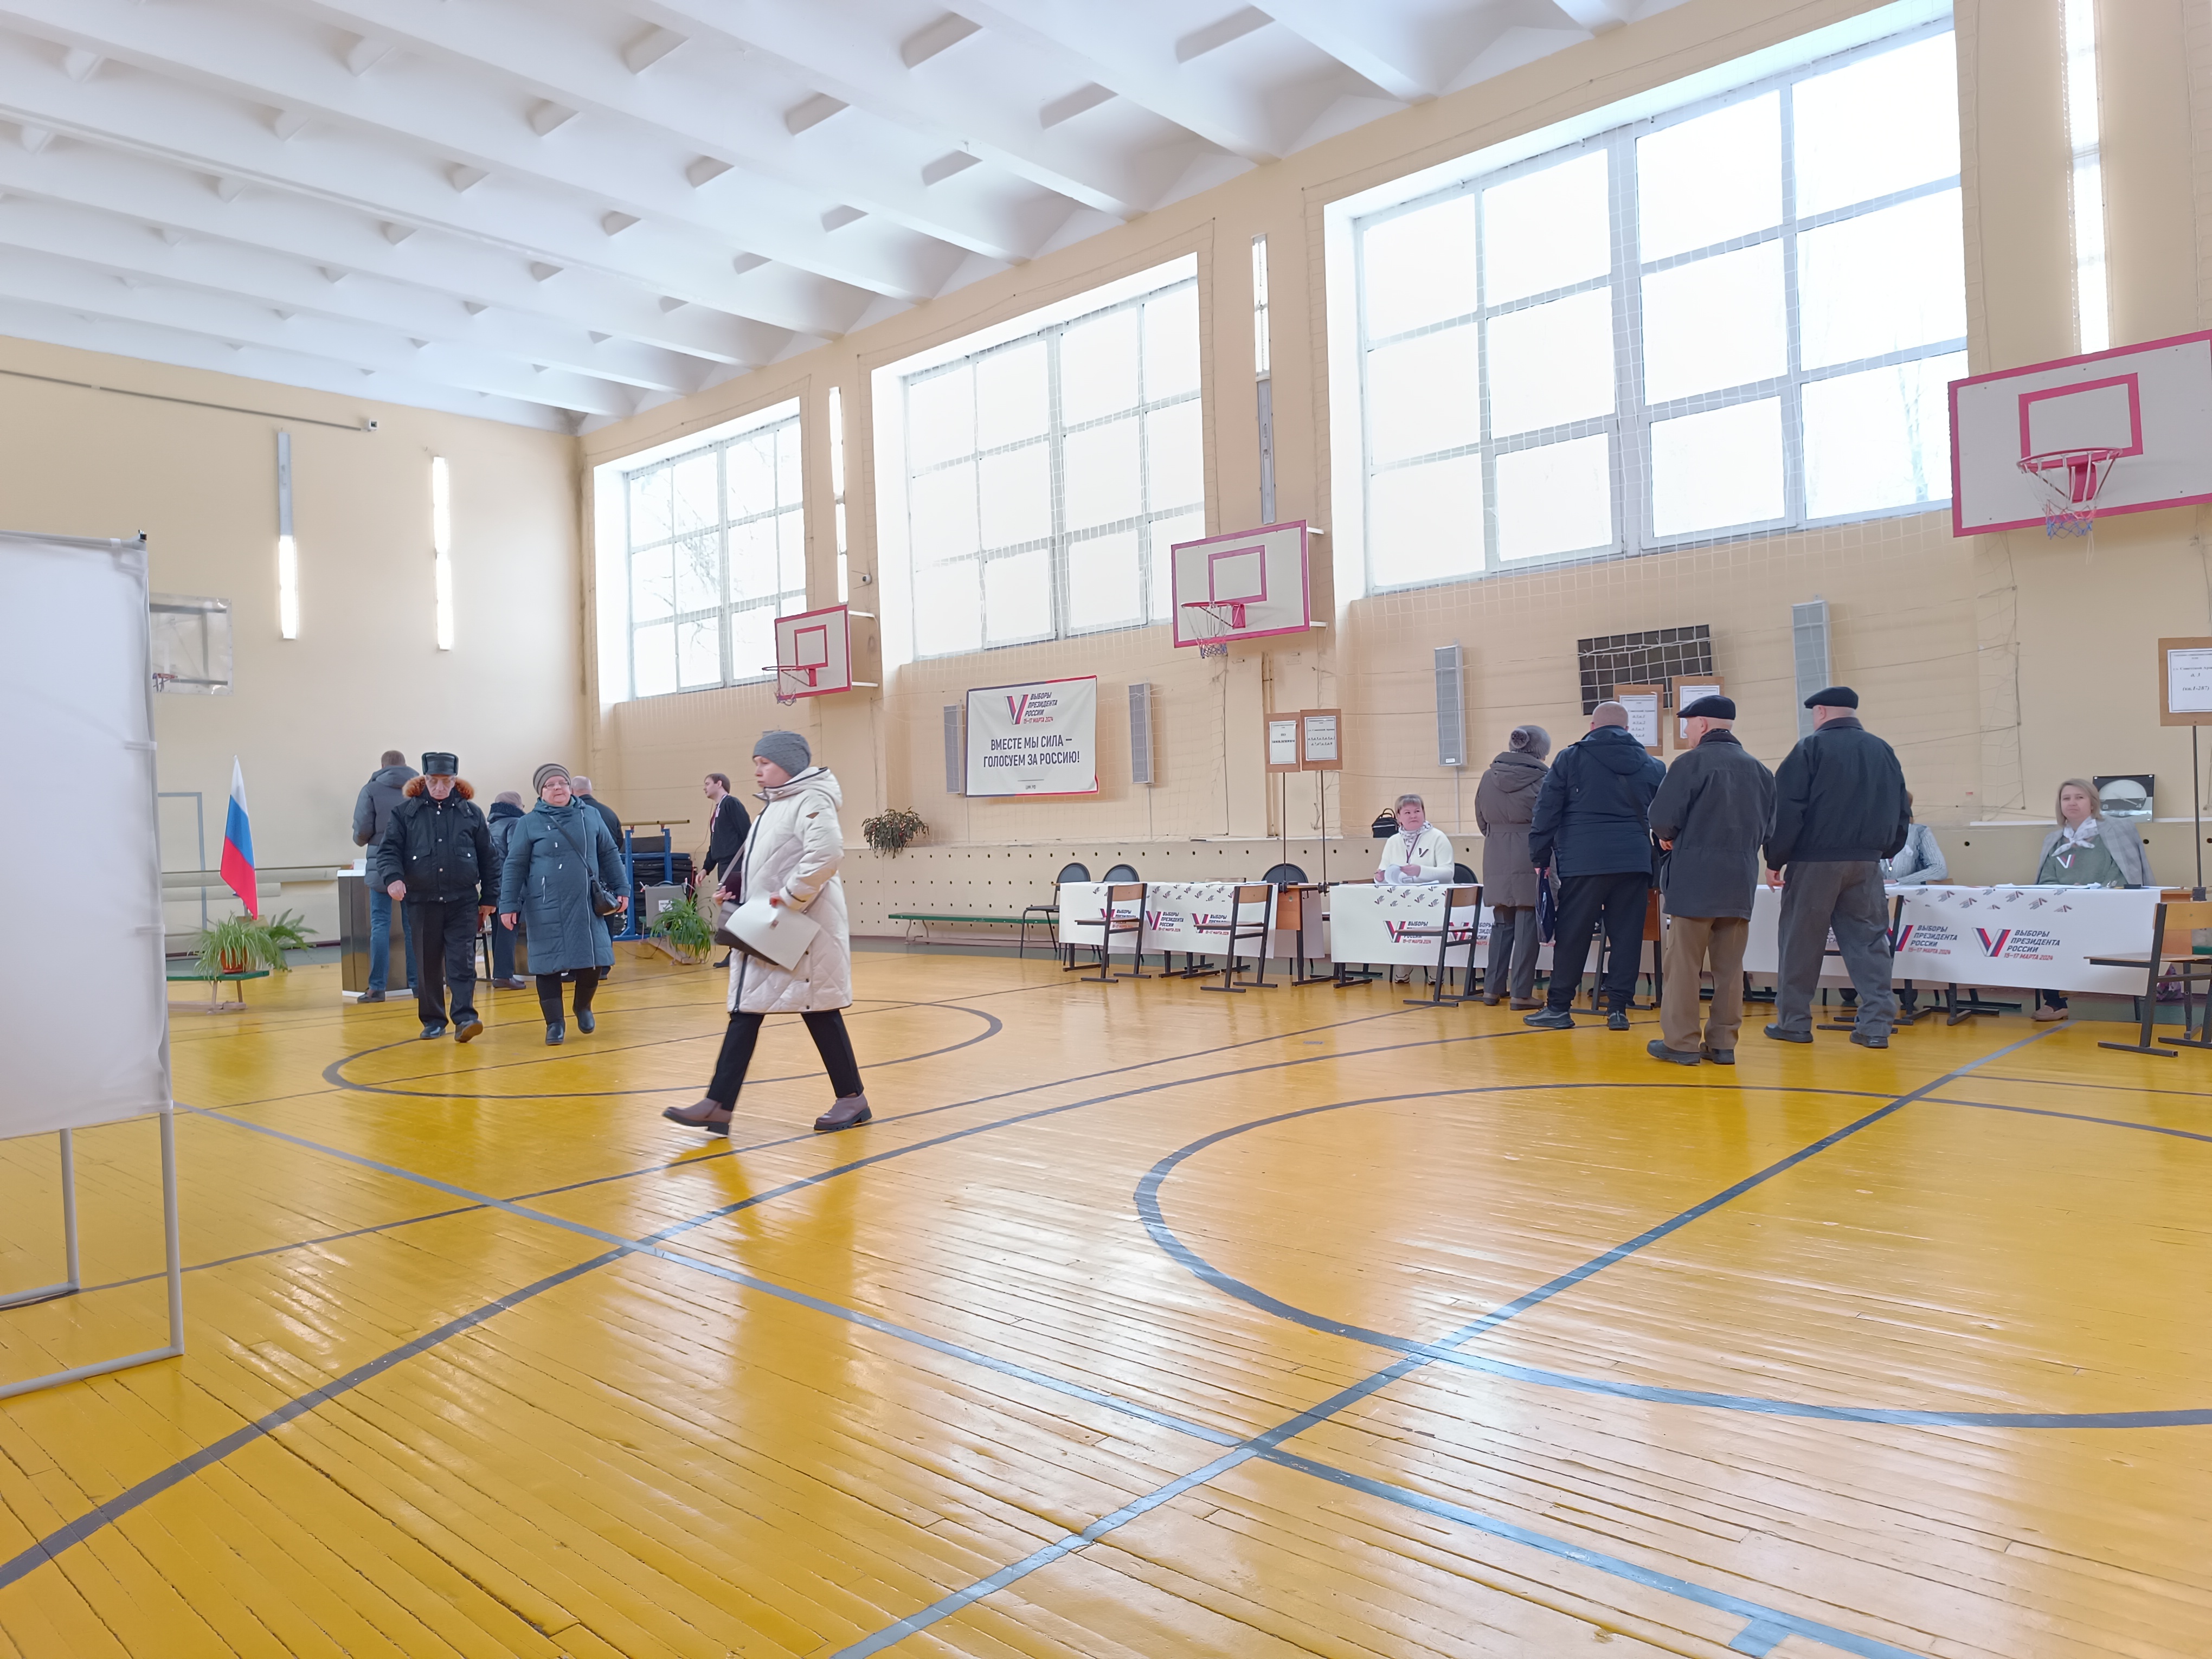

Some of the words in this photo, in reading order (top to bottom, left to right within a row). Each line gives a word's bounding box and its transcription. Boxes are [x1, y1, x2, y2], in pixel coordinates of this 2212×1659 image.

[1030, 692, 1052, 700] ВЫБОРЫ
[1028, 700, 1058, 708] ПРЕЗИДЕНТА
[991, 737, 1022, 750] ВМЕСТЕ
[1024, 736, 1038, 749] МЫ
[1041, 735, 1064, 748] СИЛА
[983, 754, 1025, 768] ГОЛОСУЕМ
[1027, 754, 1038, 766] ЗА
[1040, 751, 1079, 765] РОССИЮ!
[1913, 933, 1958, 941] ПРЕЗИДЕНТА
[2010, 937, 2060, 946] ПРЕЗИДЕНТА
